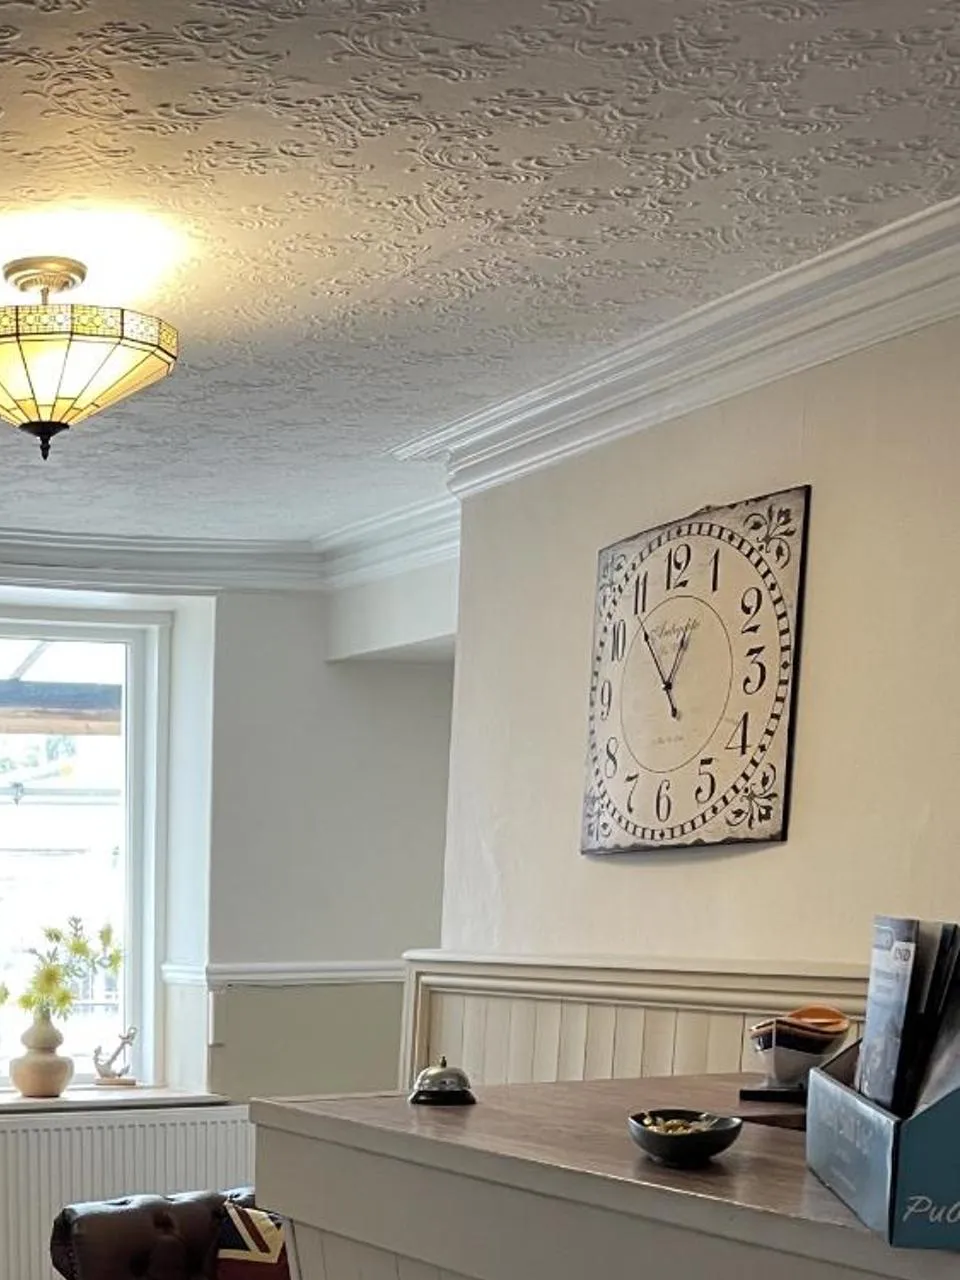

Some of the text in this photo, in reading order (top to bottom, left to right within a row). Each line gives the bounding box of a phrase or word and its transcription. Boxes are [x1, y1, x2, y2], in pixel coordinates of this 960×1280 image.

[665, 544, 692, 590] 12
[708, 549, 721, 592] 1
[634, 571, 648, 616] 11
[741, 587, 763, 634] 2
[612, 619, 627, 662] 10
[743, 646, 767, 695] 3
[600, 680, 612, 721] 9
[725, 712, 753, 756] 4
[605, 737, 619, 779] 8
[625, 774, 640, 814] 7
[655, 779, 671, 823] 6
[695, 758, 718, 803] 5
